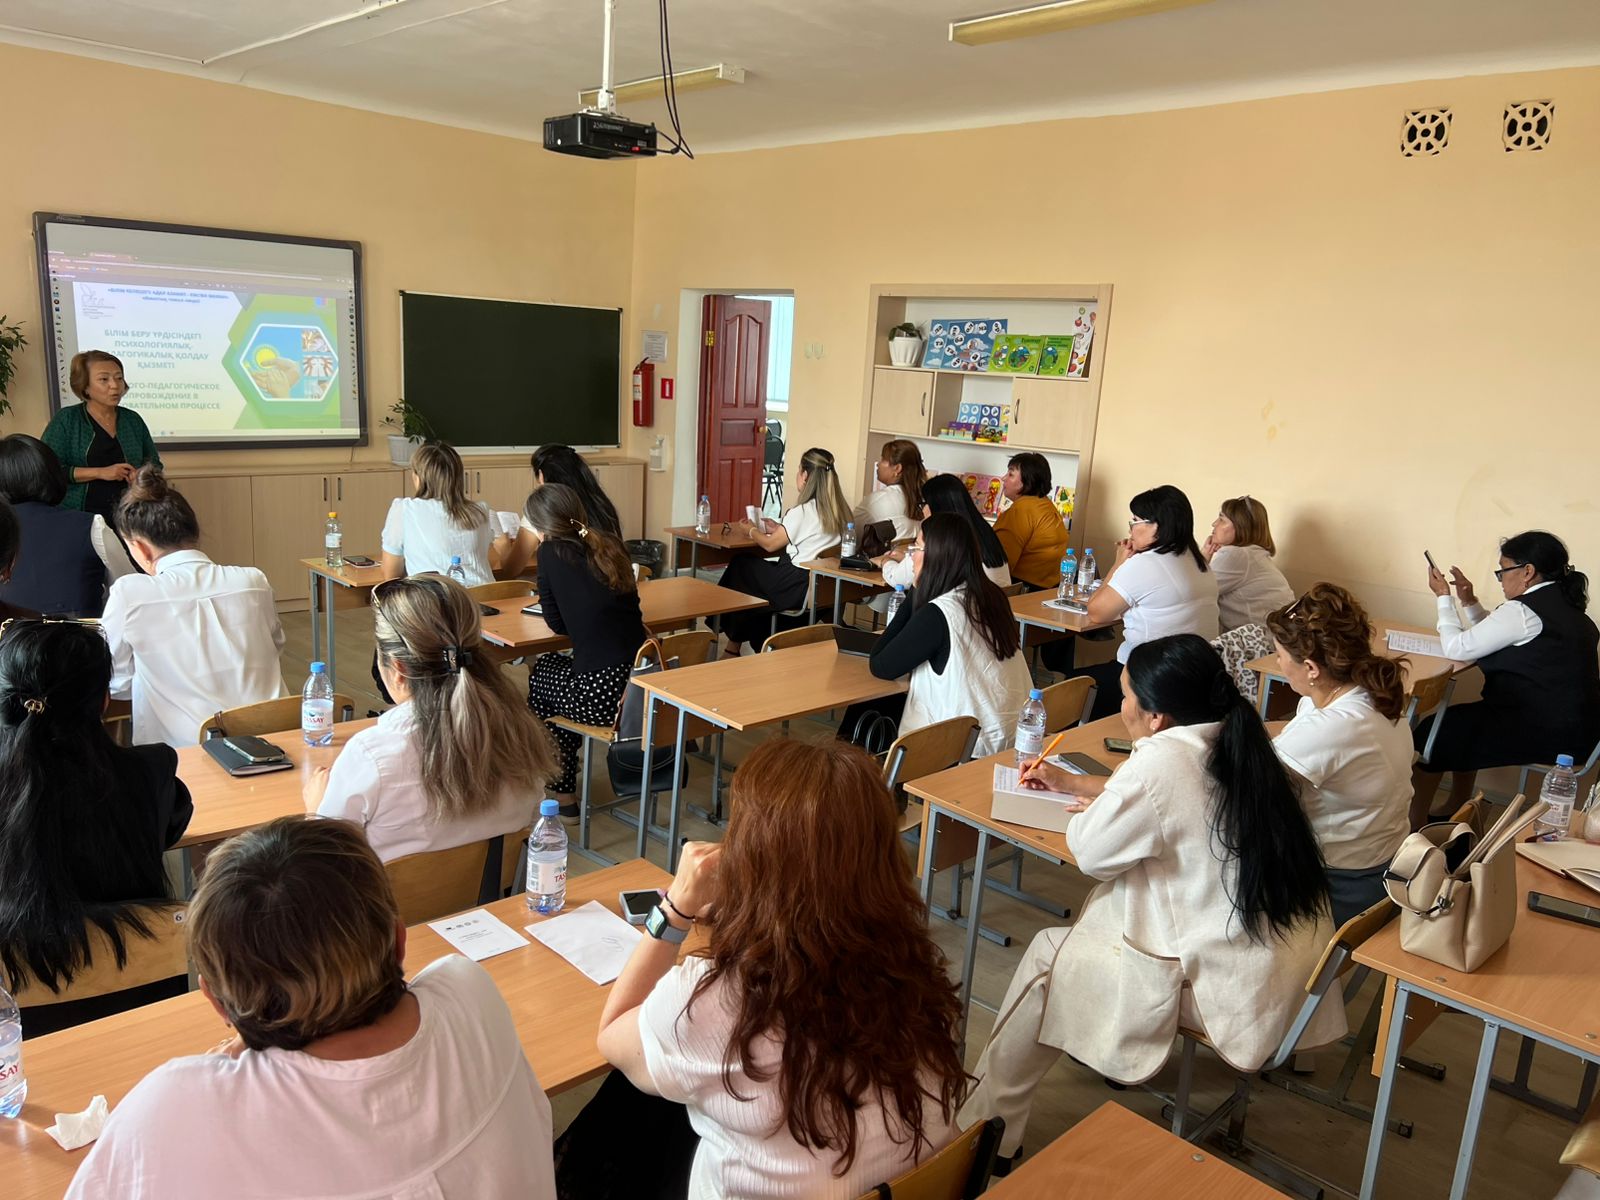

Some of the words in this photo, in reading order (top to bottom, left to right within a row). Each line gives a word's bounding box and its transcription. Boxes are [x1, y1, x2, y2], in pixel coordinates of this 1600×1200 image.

[104, 329, 129, 337] БІЛІМ
[131, 330, 151, 338] БЕРУ
[128, 382, 221, 391] ОГО-ПЕДАГОГИЧЕСКОЕ
[122, 402, 179, 410] ОВАТЕЛЬНОМ
[180, 402, 221, 410] ПРОЦЕССЕ
[175, 914, 182, 922] 6
